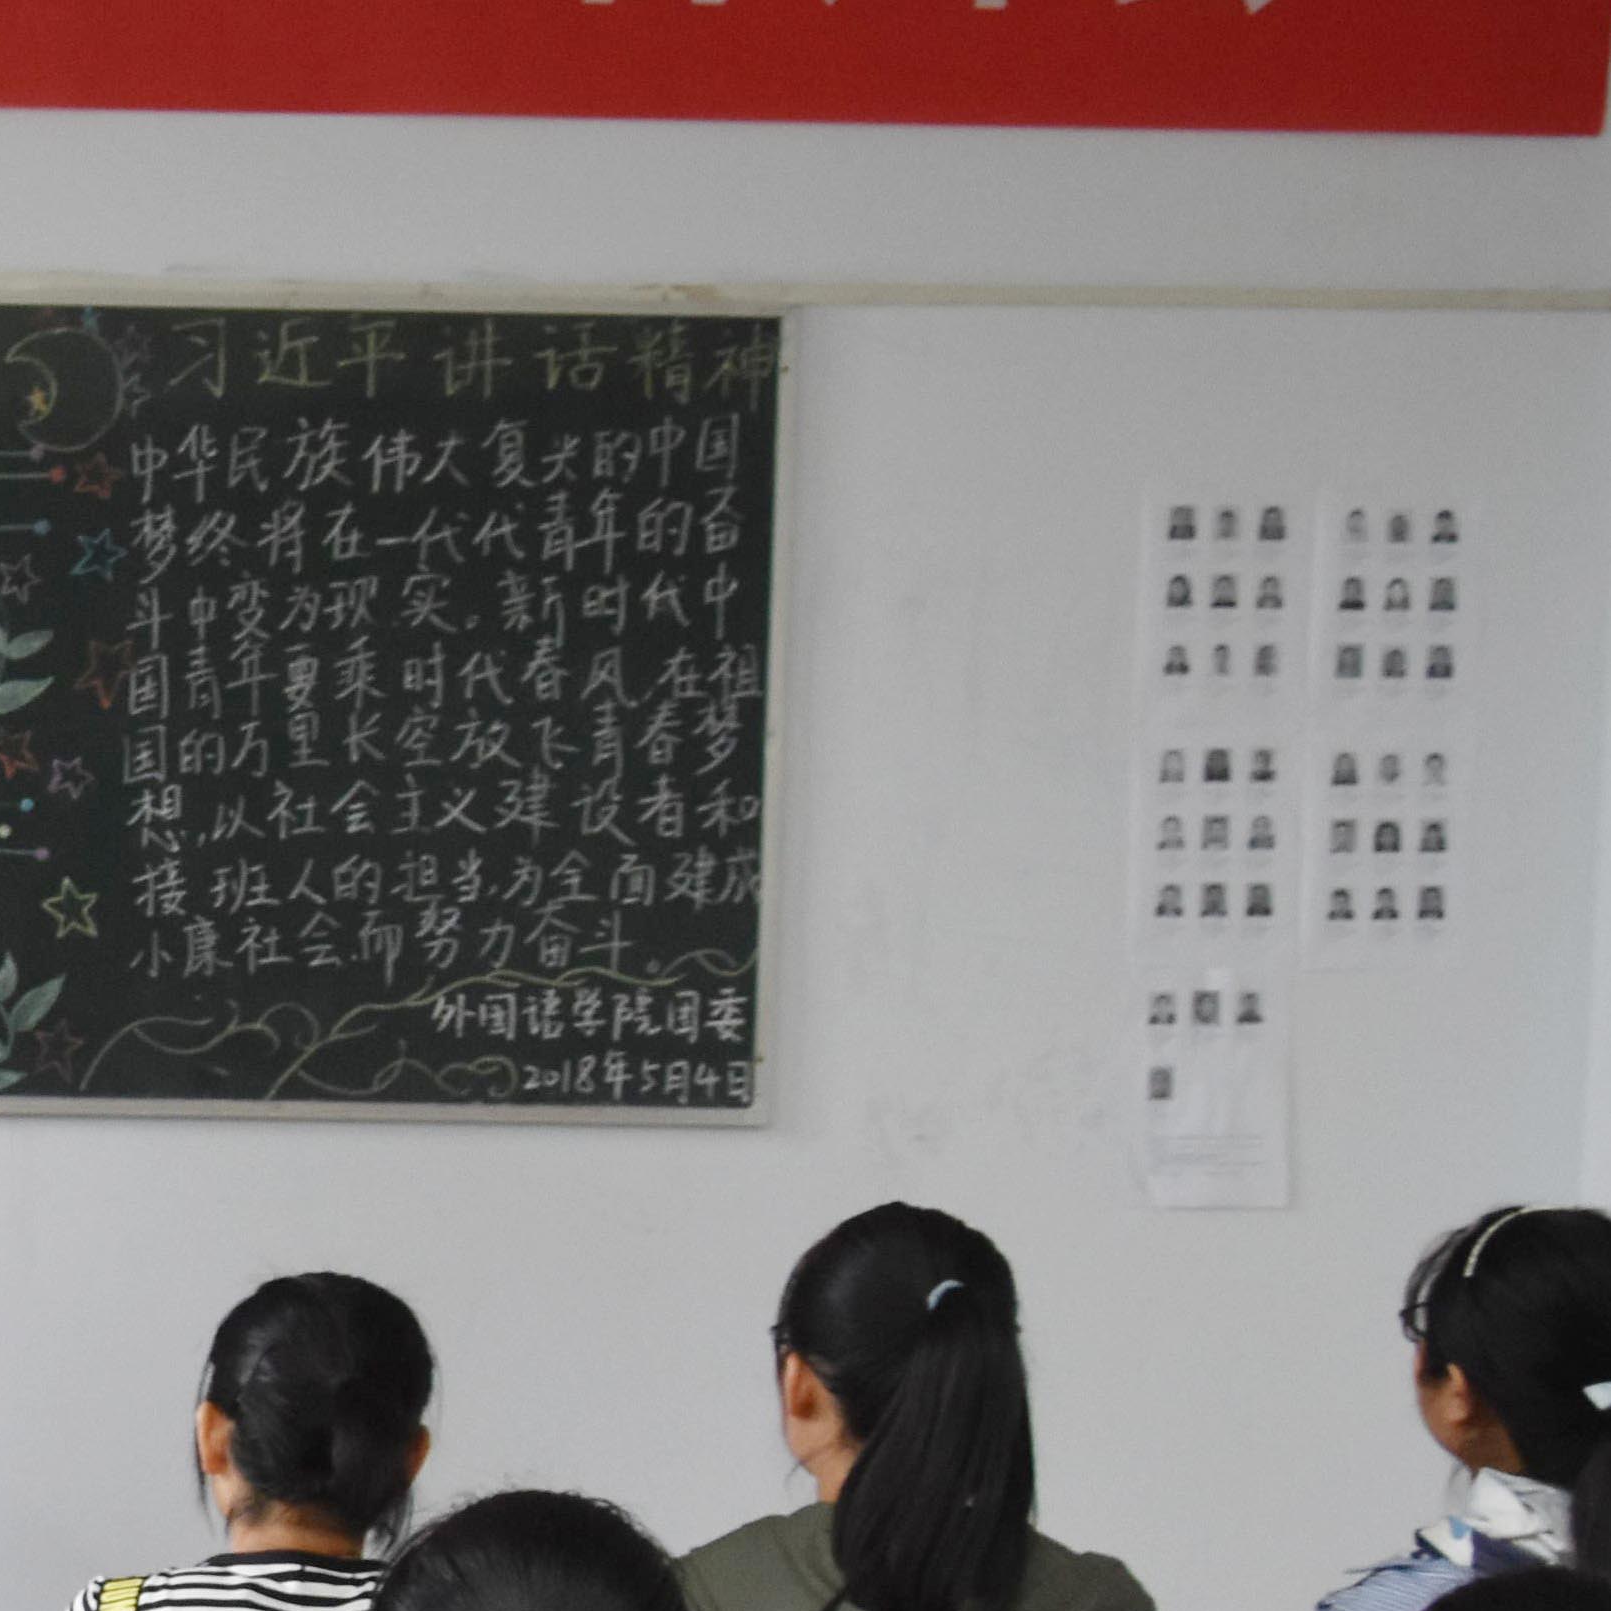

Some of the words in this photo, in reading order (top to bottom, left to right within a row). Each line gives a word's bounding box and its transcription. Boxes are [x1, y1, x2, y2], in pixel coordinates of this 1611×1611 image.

[168, 316, 774, 414] 习近平讲话精神
[131, 411, 742, 505] 中华民族伟大复兴的中国
[129, 483, 743, 586] 梦终将在一代代青年的奋
[120, 700, 743, 785] 国的万里长空放飞青春梦
[430, 986, 750, 1045] 外国语学院团委
[521, 1050, 754, 1104] 2018年5月4日
